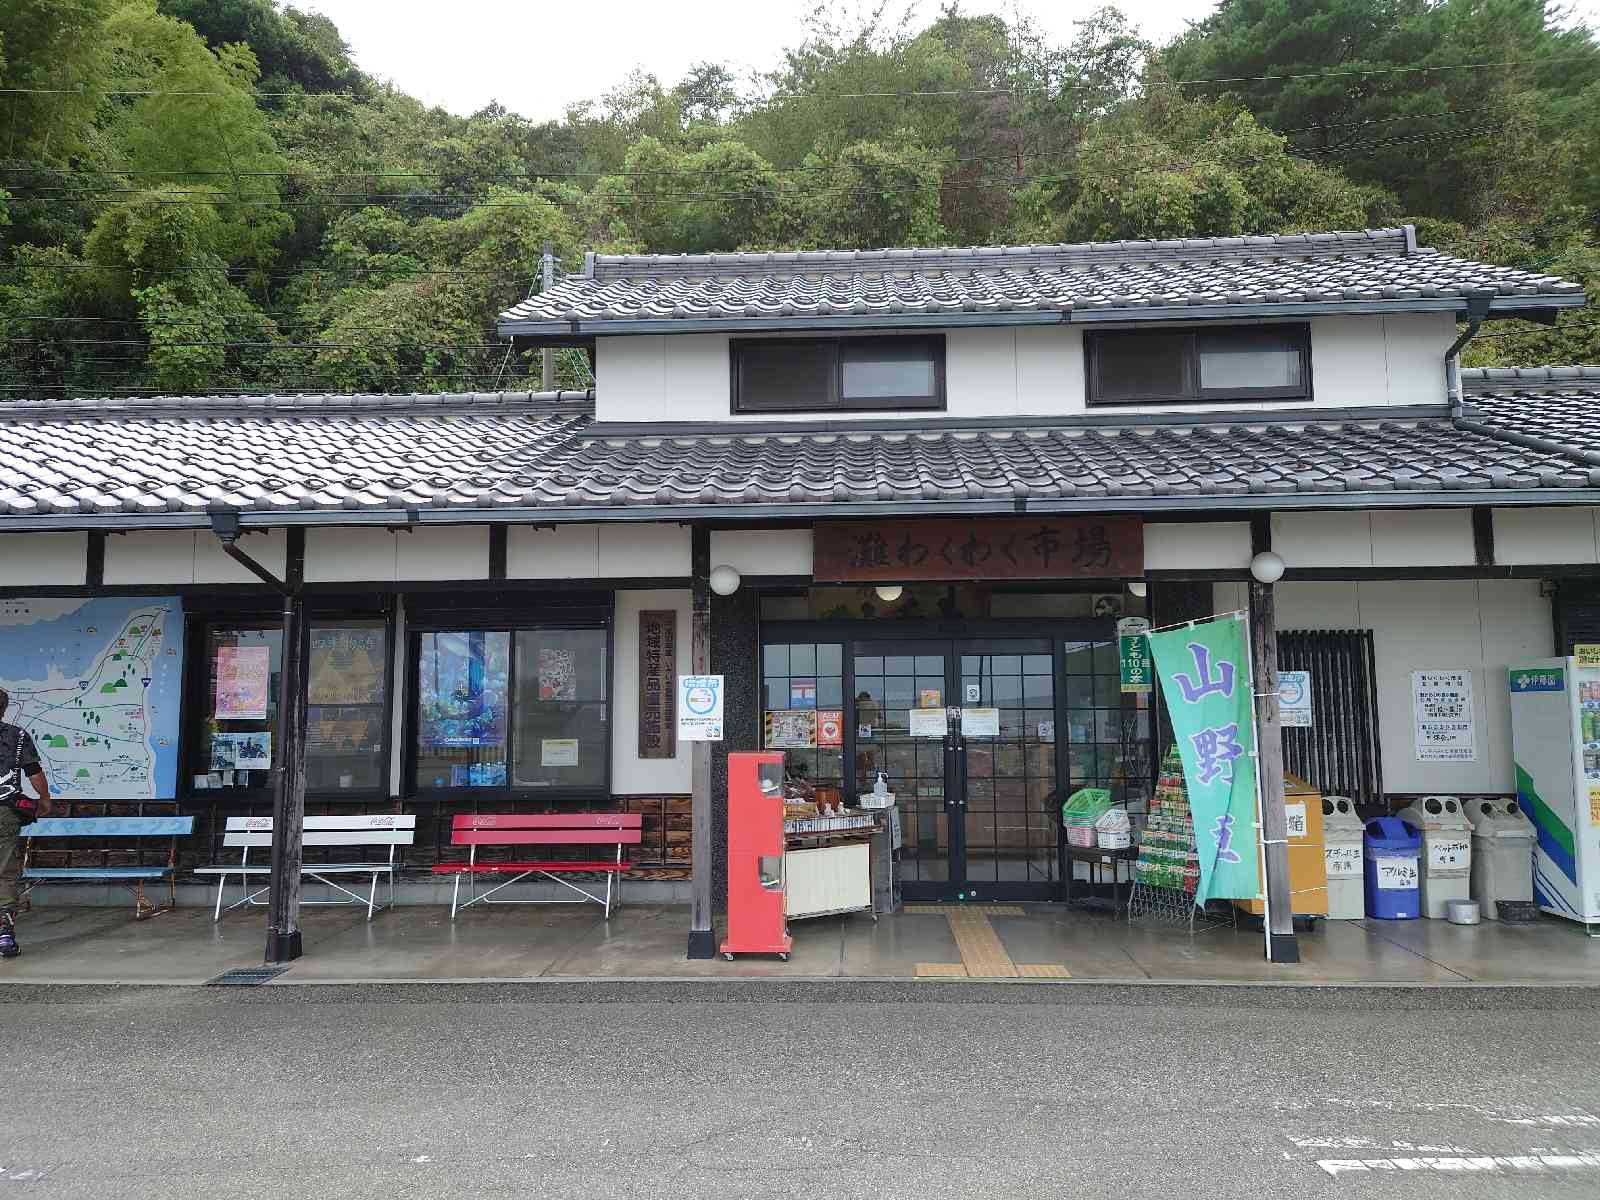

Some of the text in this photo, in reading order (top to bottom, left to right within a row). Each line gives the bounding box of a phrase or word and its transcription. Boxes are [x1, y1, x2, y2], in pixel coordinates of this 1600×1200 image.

[852, 524, 1112, 568] 灘わくわく市場
